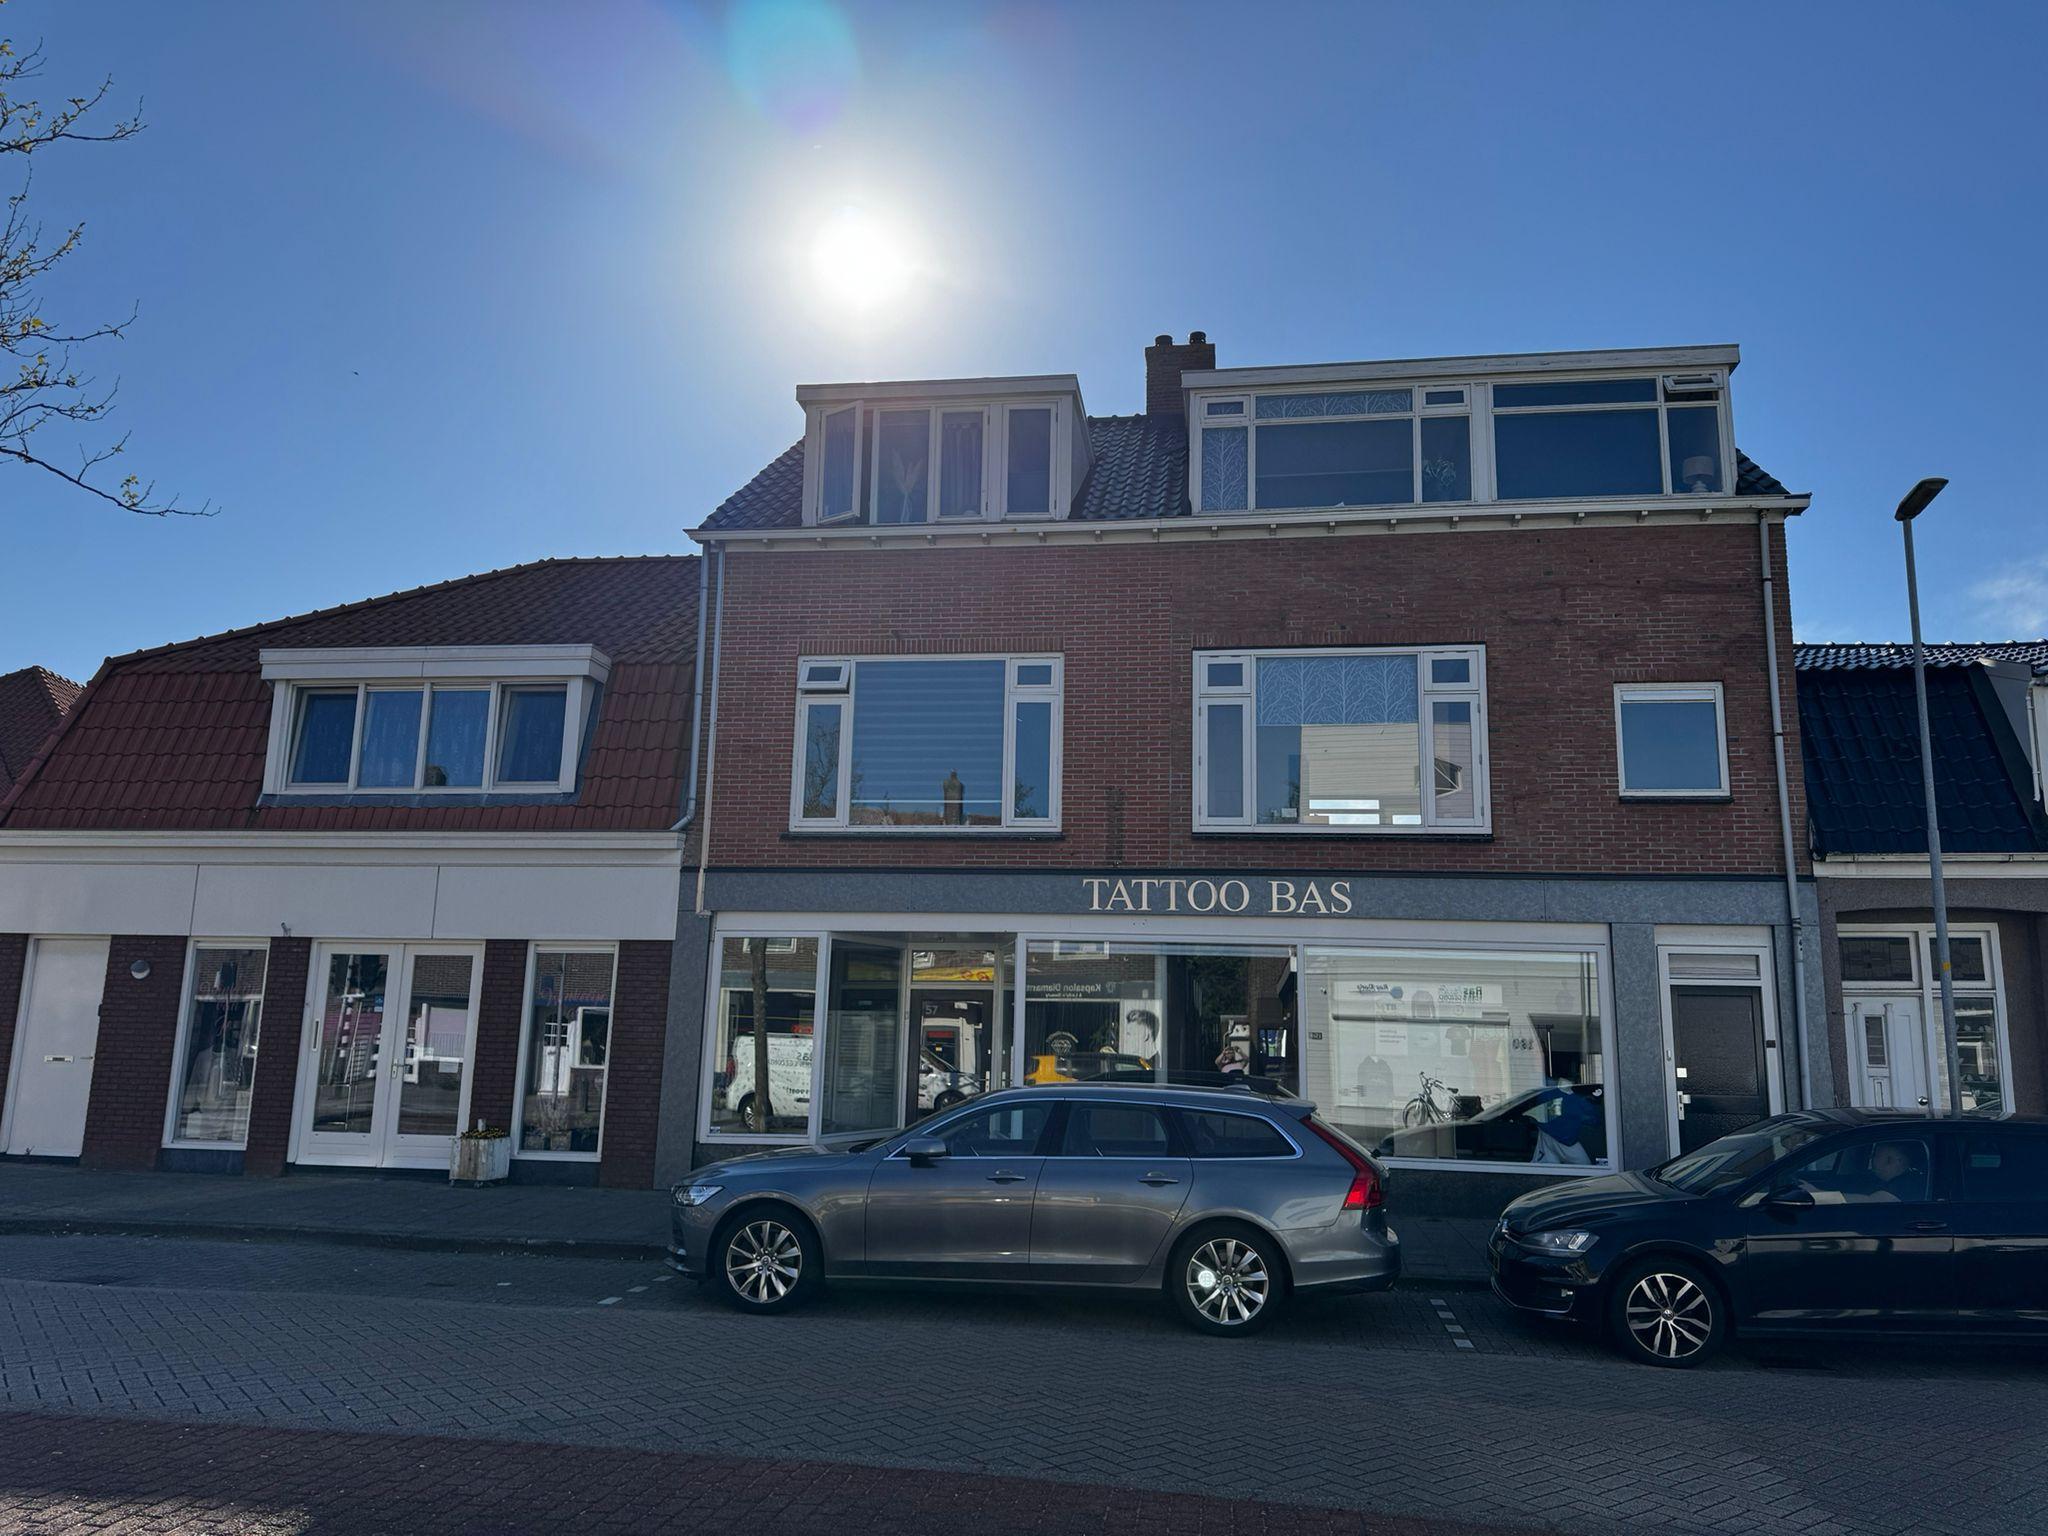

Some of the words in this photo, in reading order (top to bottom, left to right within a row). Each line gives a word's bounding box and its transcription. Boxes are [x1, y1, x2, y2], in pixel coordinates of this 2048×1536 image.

[1082, 879, 1250, 912] TATTOO
[1267, 880, 1352, 914] BAS
[926, 1005, 938, 1015] 57
